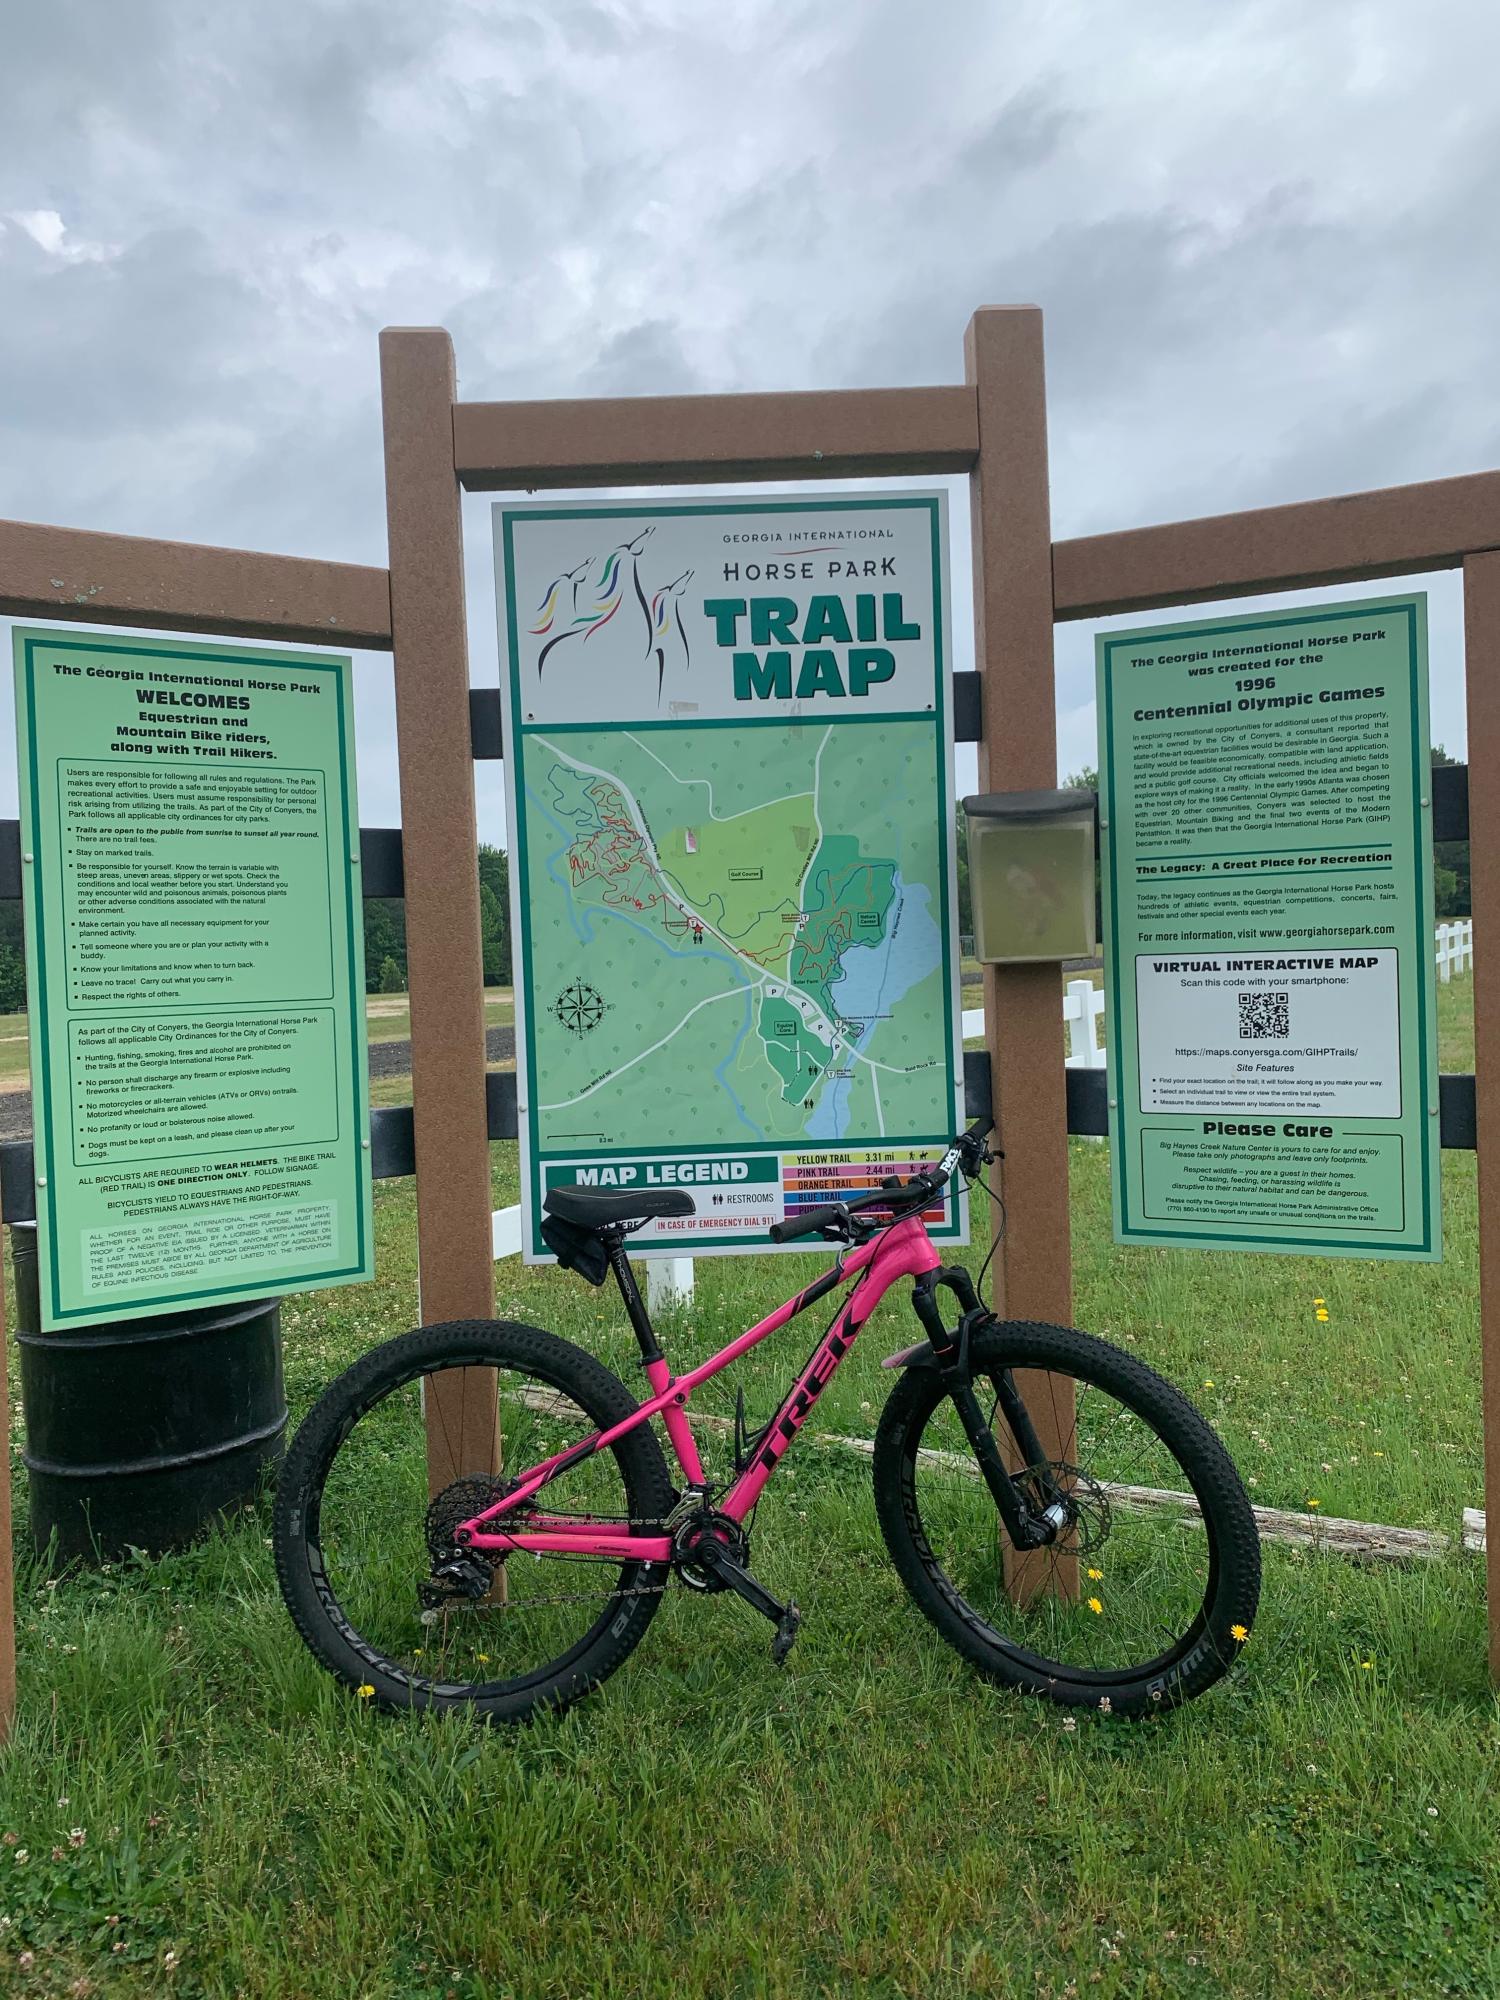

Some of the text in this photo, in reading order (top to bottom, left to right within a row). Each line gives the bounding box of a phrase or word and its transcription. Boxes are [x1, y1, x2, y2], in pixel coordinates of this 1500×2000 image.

[722, 529, 894, 544] GEORGIA INTERNATIONAL
[723, 556, 896, 582] HORSE PARK
[704, 592, 921, 647] TRAIL
[1130, 629, 1386, 668] The Georgia International Horse Park
[732, 648, 896, 701] MAP
[1188, 654, 1323, 677] was created for the
[52, 664, 321, 694] The Georgia International Horse Park
[1235, 677, 1276, 692] 1996
[135, 689, 250, 711] WELCOMES
[1133, 686, 1385, 722] Centennial Olympic Games
[139, 711, 248, 728] Equestrian and
[116, 726, 270, 745] Mountain Bike riders,
[110, 741, 277, 760] along with Trail Hikers.
[75, 848, 93, 857] Stay
[105, 849, 133, 857] marked
[134, 849, 154, 857] trails.
[1135, 853, 1392, 875] The Legacy: A Great Place for Recreation
[1138, 924, 1395, 942] For more information, visit www.georgiahorsepark.com
[1153, 957, 1379, 973] VIRTUAL INTERACTIVE MAP
[1180, 976, 1349, 988] Scan this code with your smartphone:
[81, 993, 112, 1002] Respect
[126, 991, 147, 1000] rights
[77, 1028, 89, 1036] As
[90, 1027, 106, 1037] part
[106, 1026, 115, 1034] of
[116, 1026, 130, 1034] the
[130, 1025, 146, 1034] City
[147, 1024, 156, 1032] of
[156, 1024, 190, 1033] Conyers,
[205, 1021, 234, 1030] Georgia
[235, 1018, 279, 1027] International
[302, 1016, 318, 1024] Park
[1236, 1063, 1295, 1072] Site Features
[1203, 1121, 1333, 1139] Please Care
[796, 1154, 852, 1165] YELLOW TRAIL
[865, 1151, 895, 1162] 3.31 mi
[78, 1177, 94, 1185] ALL
[95, 1172, 141, 1184] BICYCLISTS
[142, 1170, 159, 1179] ARE
[160, 1166, 201, 1177] REQUIRED
[201, 1164, 213, 1173] TO
[213, 1162, 239, 1171] WEAR
[240, 1158, 279, 1169] HELMETS.
[298, 1154, 315, 1162] BIKE
[316, 1152, 336, 1160] TRAIL
[575, 1161, 749, 1186] MAP LEGEND
[797, 1167, 840, 1178] PINK TRAIL
[866, 1165, 895, 1176] 2.44 mi
[100, 1163, 319, 1194] (RED TRAIL) IS ONE DIRECTION ONLY. FOLLOW SIGNAGE.
[798, 1179, 830, 1190] ORANGE
[831, 1179, 854, 1189] TRAIL
[107, 1179, 312, 1209] BICYCLISTS YIELD TO EQUESTRIANS AND PEDESTRIANS.
[727, 1193, 774, 1204] RESTROOMS
[798, 1191, 843, 1203] BLUE TRAIL
[123, 1190, 300, 1217] PEDESTRIANS ALWAYS HAVE THE RIGHT-OF-WAY.
[657, 1216, 776, 1230] IN CASE OF EMERGENCY DIAL 911
[750, 1307, 865, 1474] TREK
